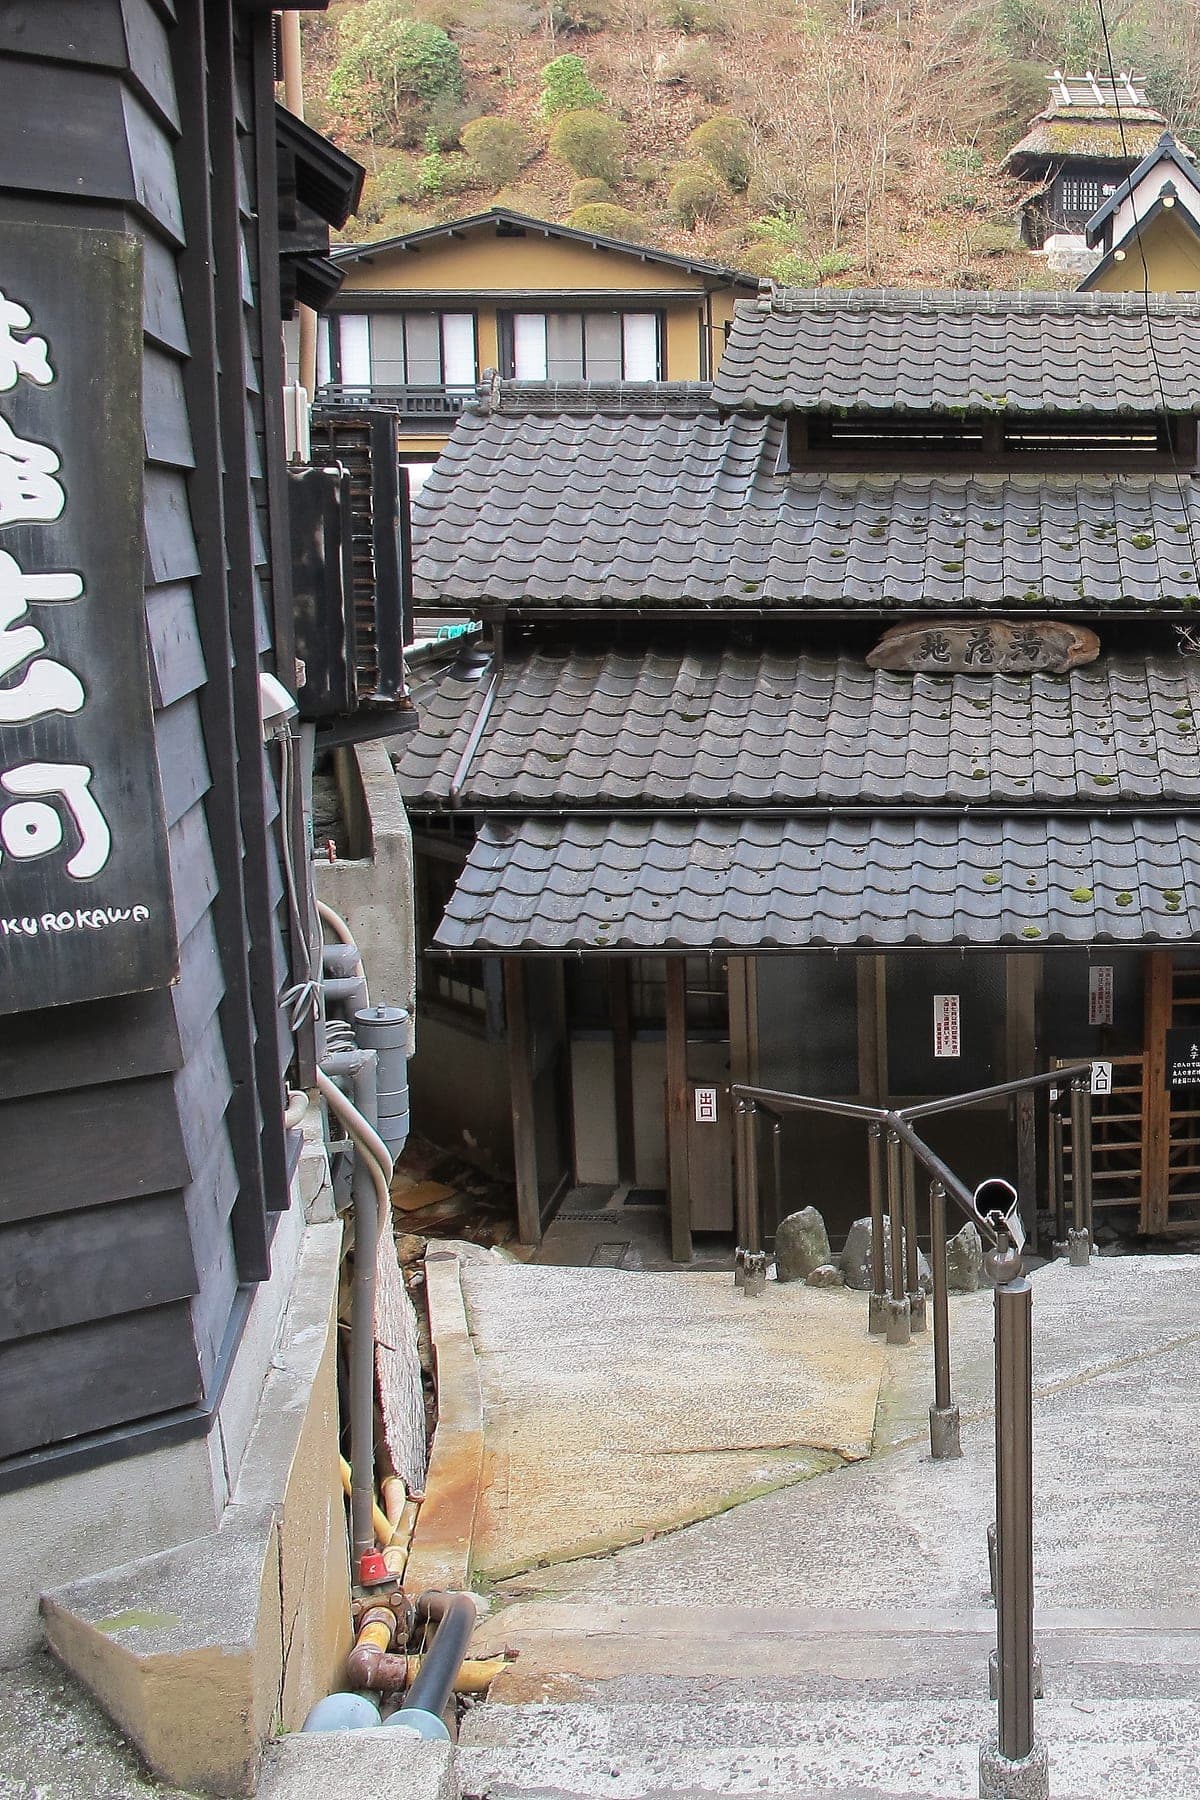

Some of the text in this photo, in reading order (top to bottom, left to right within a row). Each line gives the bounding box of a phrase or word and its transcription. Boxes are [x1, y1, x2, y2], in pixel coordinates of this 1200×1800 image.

[920, 628, 1044, 665] 地蔵湯
[1, 904, 150, 936] KUROKAWA
[1096, 1066, 1108, 1091] 入口
[700, 1092, 713, 1117] 出口
